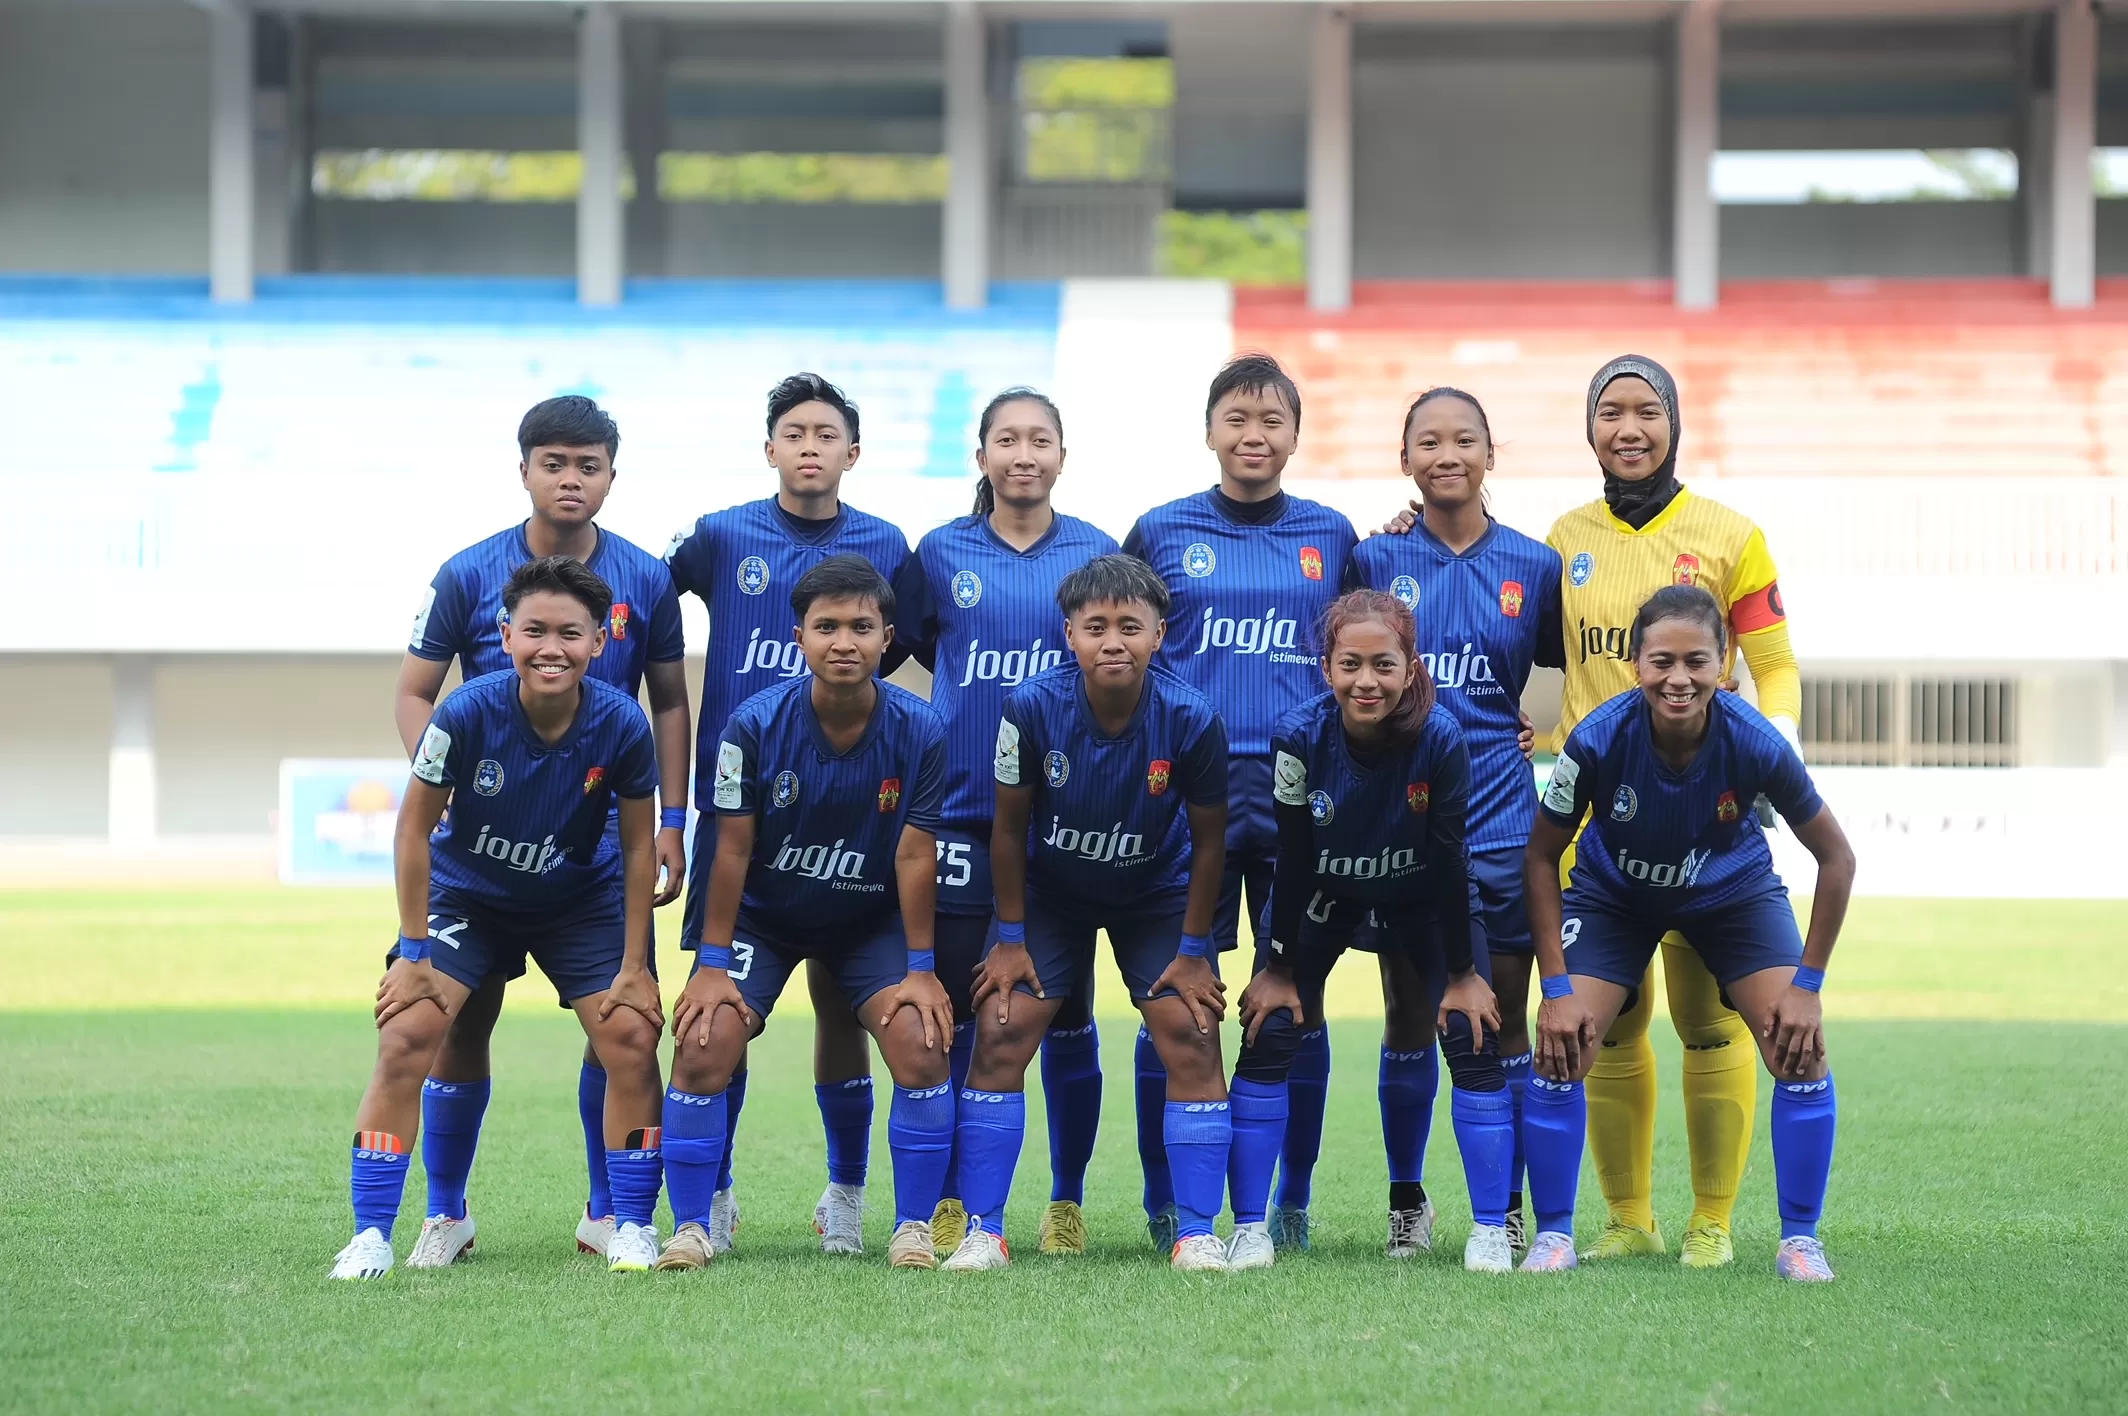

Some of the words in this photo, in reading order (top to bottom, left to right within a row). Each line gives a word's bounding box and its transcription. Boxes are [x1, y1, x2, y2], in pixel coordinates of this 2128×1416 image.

[736, 627, 812, 677] jog
[1194, 606, 1297, 655] jogja
[1580, 617, 1635, 664] jog
[1269, 651, 1317, 665] istimewa
[1419, 642, 1496, 688] ogja
[764, 833, 866, 880] jogja
[1043, 815, 1144, 862] jogja
[831, 879, 885, 892] istimewa
[1313, 846, 1418, 880] jogja
